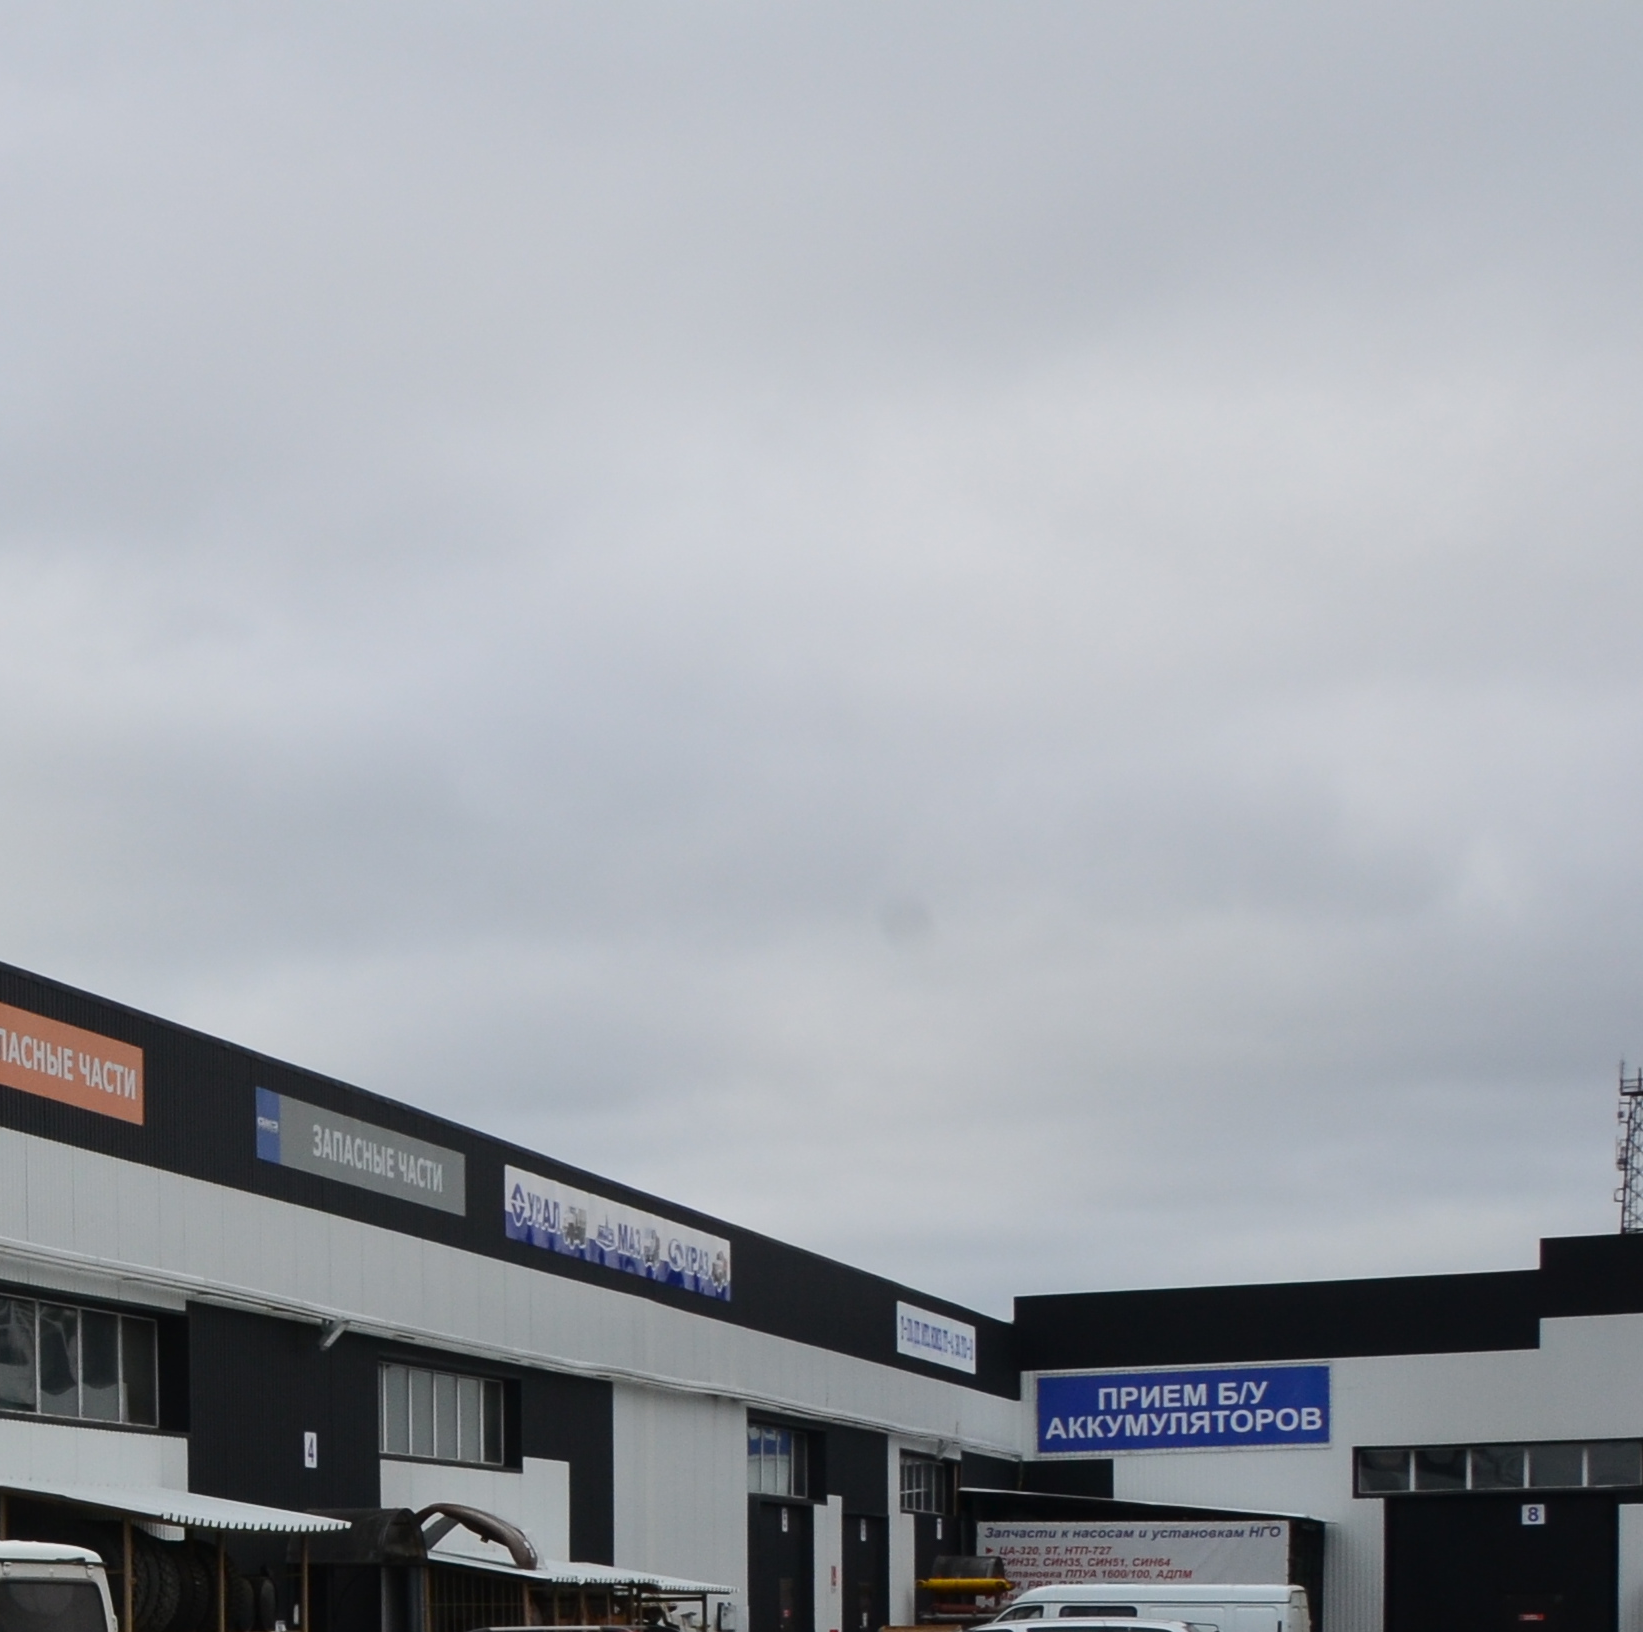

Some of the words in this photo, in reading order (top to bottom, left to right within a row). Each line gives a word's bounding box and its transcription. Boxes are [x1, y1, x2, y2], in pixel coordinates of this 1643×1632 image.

[79, 1055, 136, 1100] ЧАСТИ
[312, 1123, 394, 1178] ЗАПАСНЫЕ
[398, 1150, 443, 1193] ЧАСТИ
[527, 1192, 560, 1233] УРАЛ
[618, 1223, 641, 1257] МАЗ
[1098, 1384, 1207, 1410] ПРИЕМ
[1217, 1381, 1269, 1407] Б/У
[1045, 1409, 1322, 1441] АККУМУЛЯТОРОВ
[308, 1438, 314, 1463] 4
[1528, 1507, 1539, 1522] 8
[985, 1527, 1056, 1539] Запчасти
[1060, 1529, 1070, 1538] к
[1073, 1529, 1134, 1538] насосам
[1139, 1529, 1147, 1538] и
[1152, 1529, 1244, 1541] установкам
[1249, 1527, 1281, 1538] НГО
